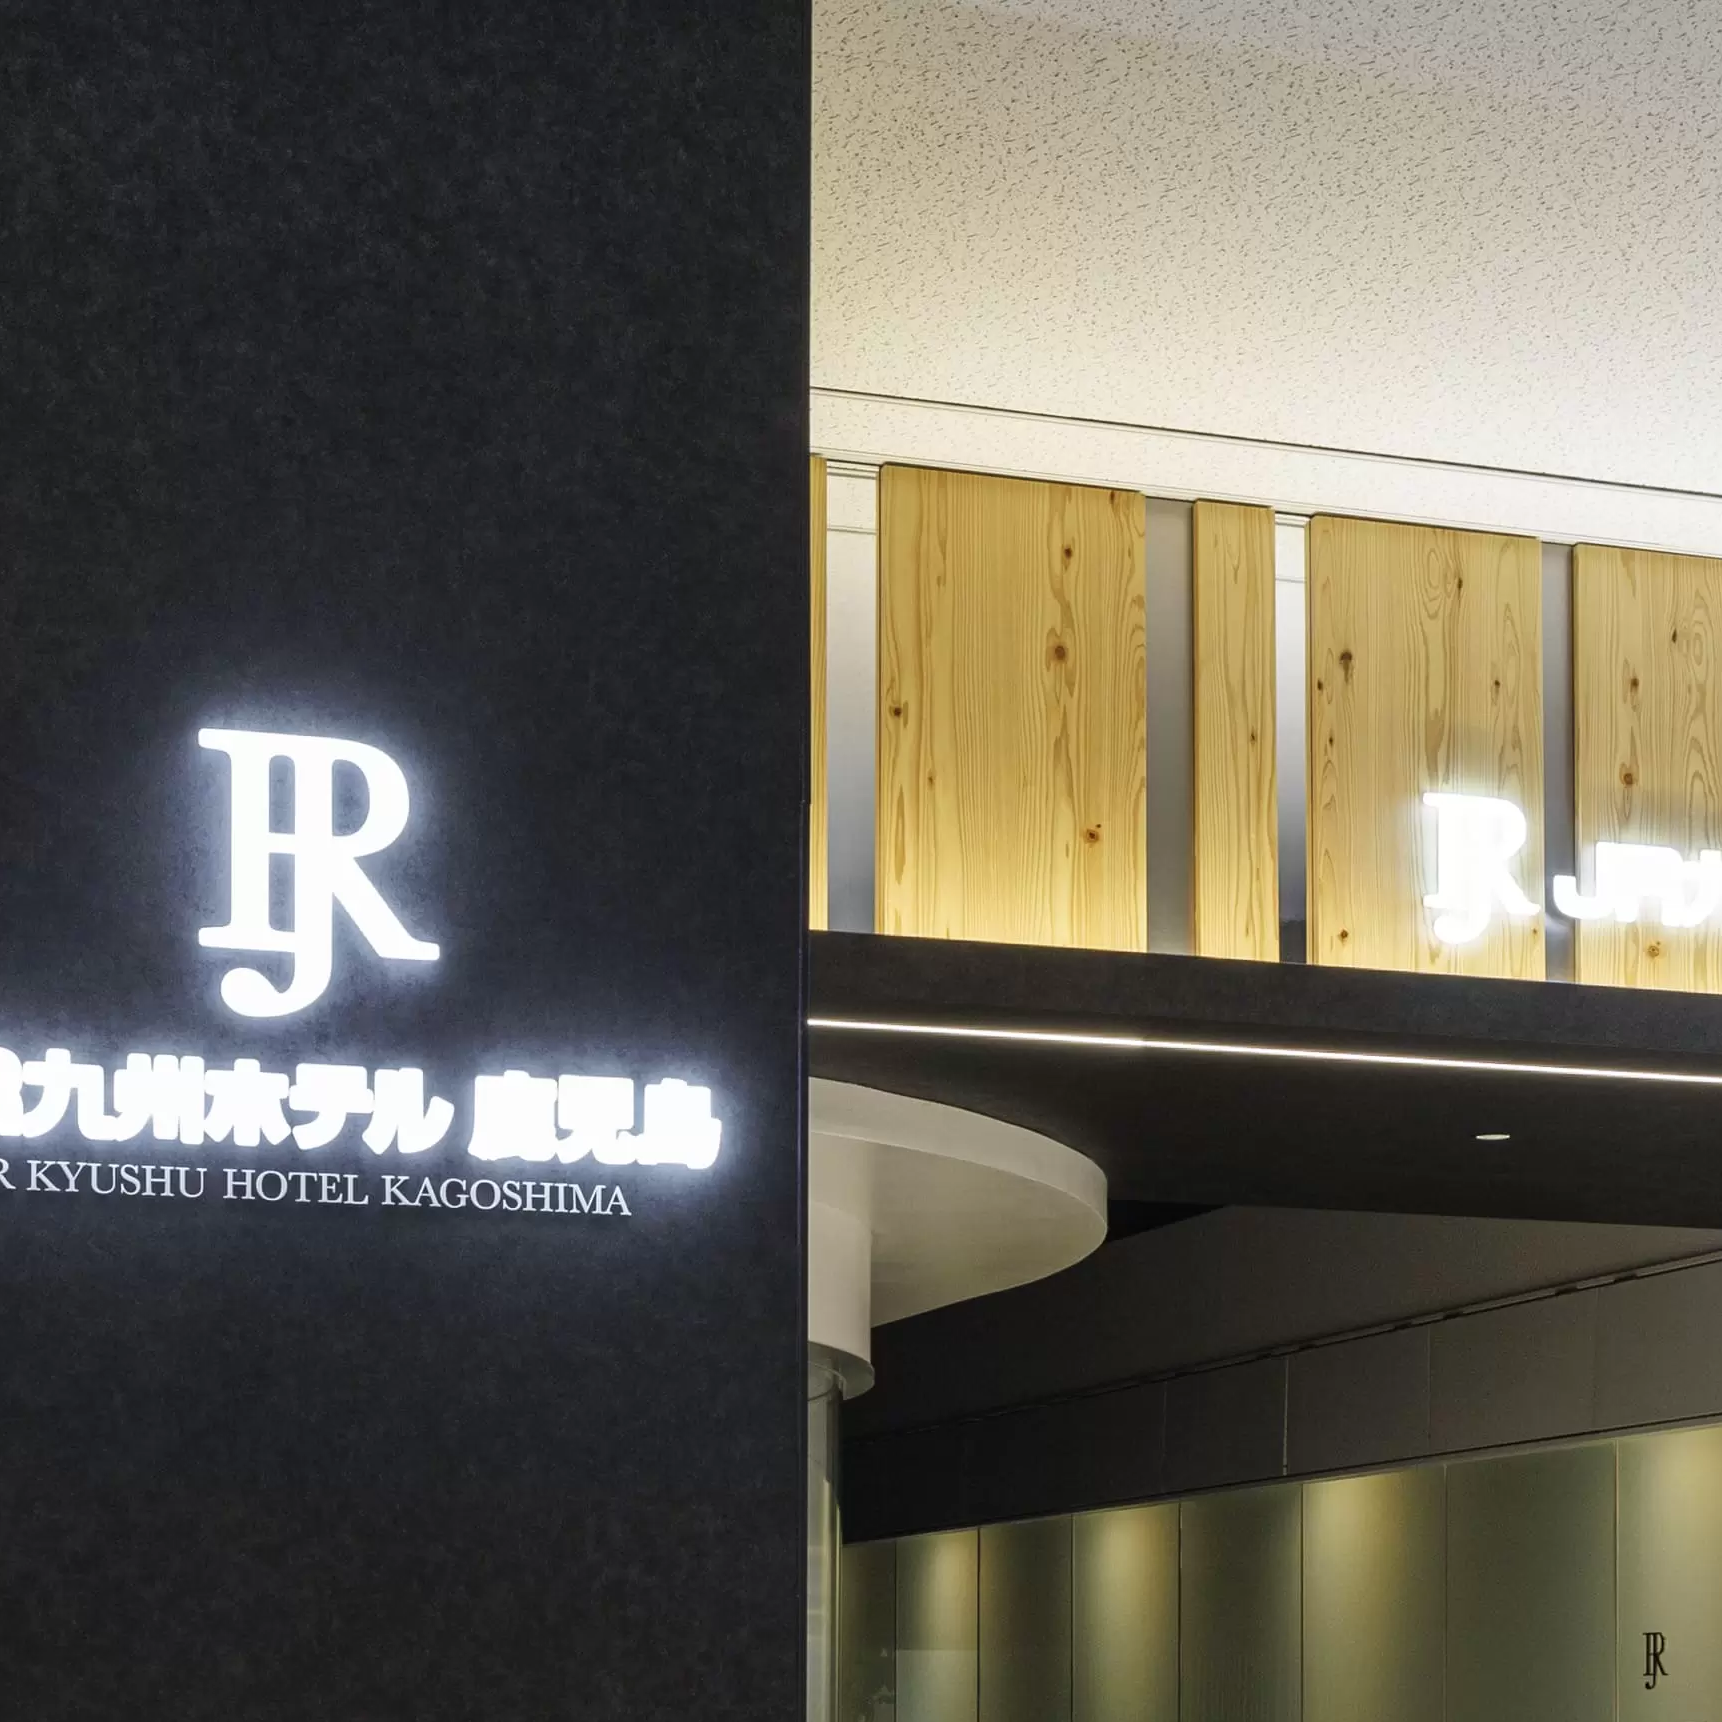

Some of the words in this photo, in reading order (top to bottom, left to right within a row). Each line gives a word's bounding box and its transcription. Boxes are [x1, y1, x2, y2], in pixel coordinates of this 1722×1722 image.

[27, 1159, 206, 1199] KYUSHU
[224, 1168, 369, 1206] HOTEL
[381, 1174, 632, 1216] KAGOSHIMA
